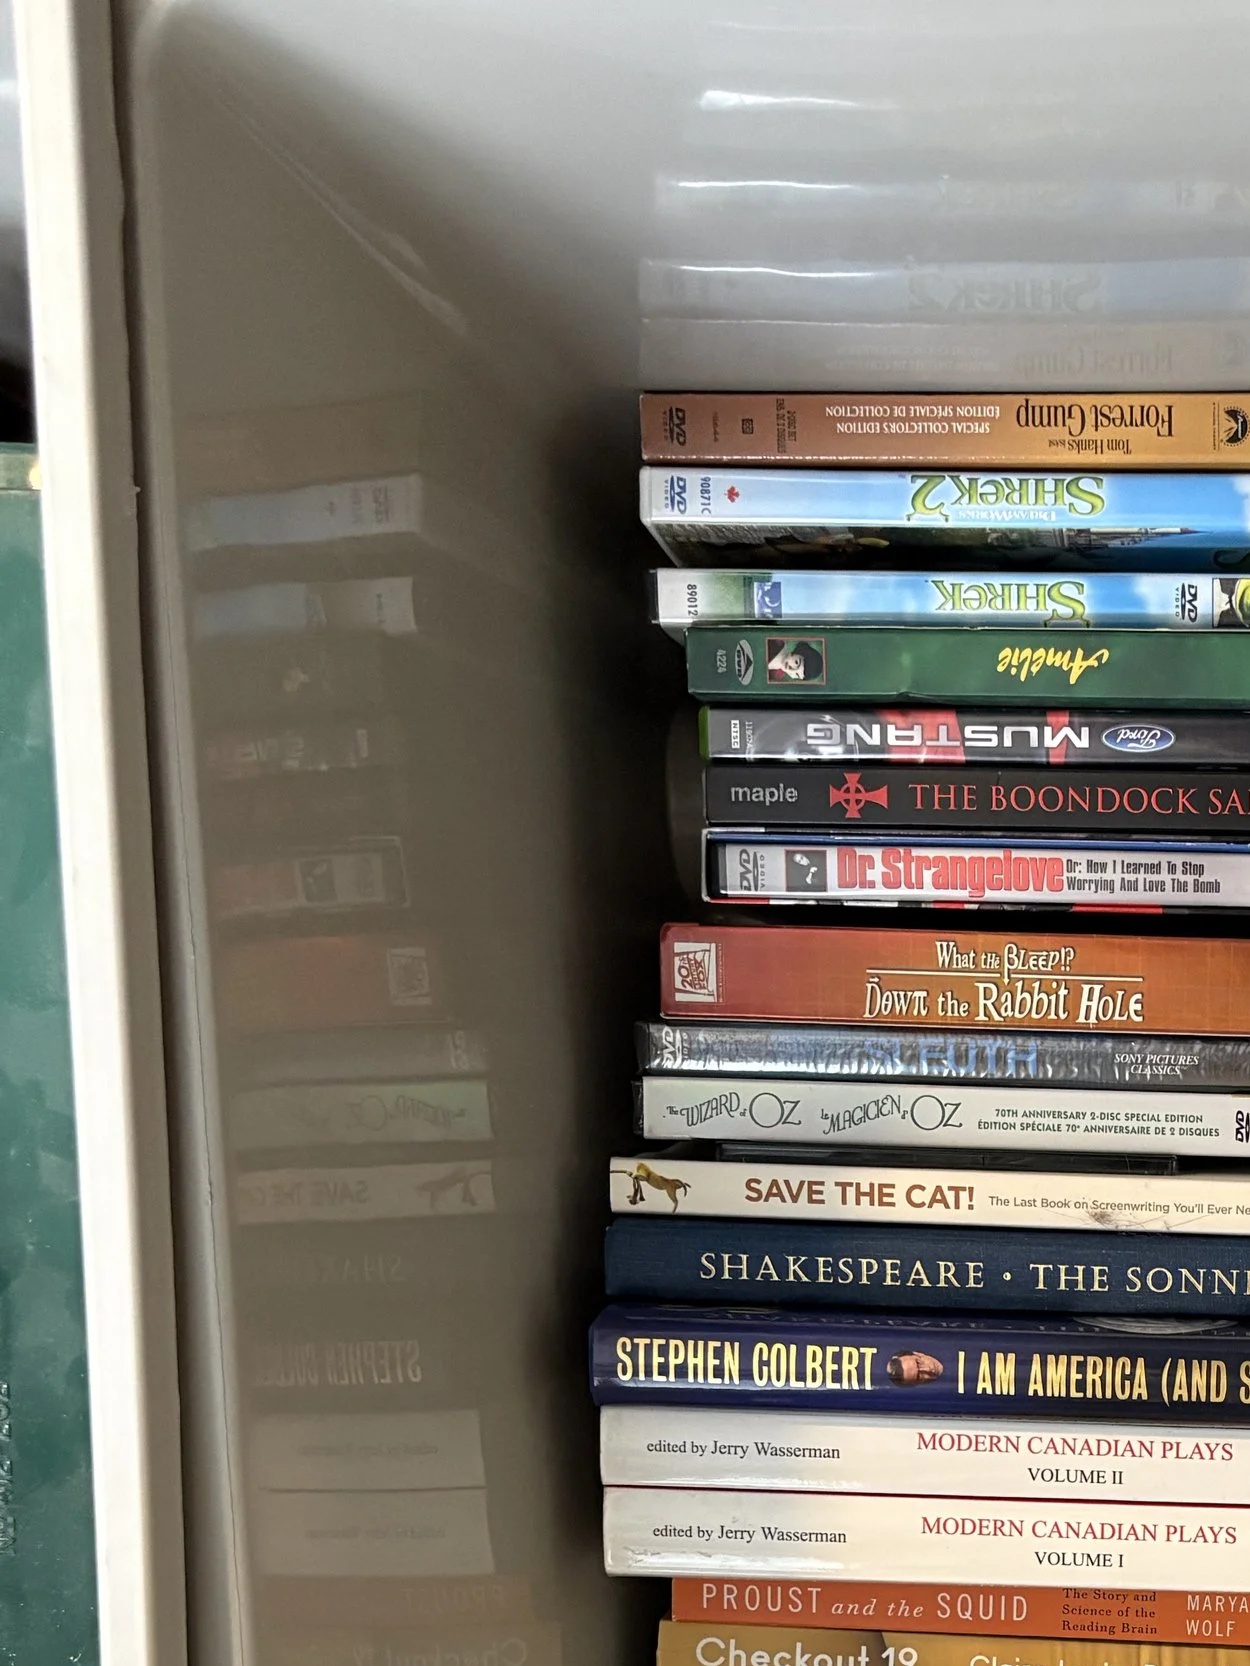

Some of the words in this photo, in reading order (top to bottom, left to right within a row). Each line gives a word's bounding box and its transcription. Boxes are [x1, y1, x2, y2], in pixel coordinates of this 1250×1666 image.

[1016, 399, 1086, 437] Gump
[1095, 405, 1174, 437] Forrest
[686, 584, 698, 617] 89012
[806, 723, 1089, 750] MUSTANG
[730, 782, 799, 806] maple
[909, 783, 978, 811] THE
[990, 784, 1200, 815] BOONDOCK
[836, 847, 875, 890] Dr.
[880, 847, 1065, 899] Strangelove
[745, 1178, 826, 1205] SAVE
[834, 1181, 896, 1208] THE
[904, 1184, 975, 1210] CAT!
[699, 1252, 985, 1289] SHAKESPEARE
[1029, 1264, 1109, 1291] THE
[616, 1336, 740, 1385] STEPHEN
[752, 1342, 877, 1391] COLBERT
[957, 1351, 966, 1394] I
[977, 1352, 1016, 1396] AM
[1028, 1354, 1148, 1401] AMERICA
[1161, 1358, 1225, 1407] (AND
[917, 1432, 1021, 1454] MODERN
[1027, 1436, 1155, 1459] CANADIAN
[1160, 1441, 1234, 1462] PLAYS
[1027, 1467, 1107, 1485] VOLUME
[1111, 1470, 1124, 1485] II
[702, 1583, 822, 1613] PROUST
[831, 1598, 877, 1617] and
[887, 1599, 924, 1618] the
[936, 1593, 1029, 1621] SQUID
[1186, 1620, 1236, 1638] WOLF
